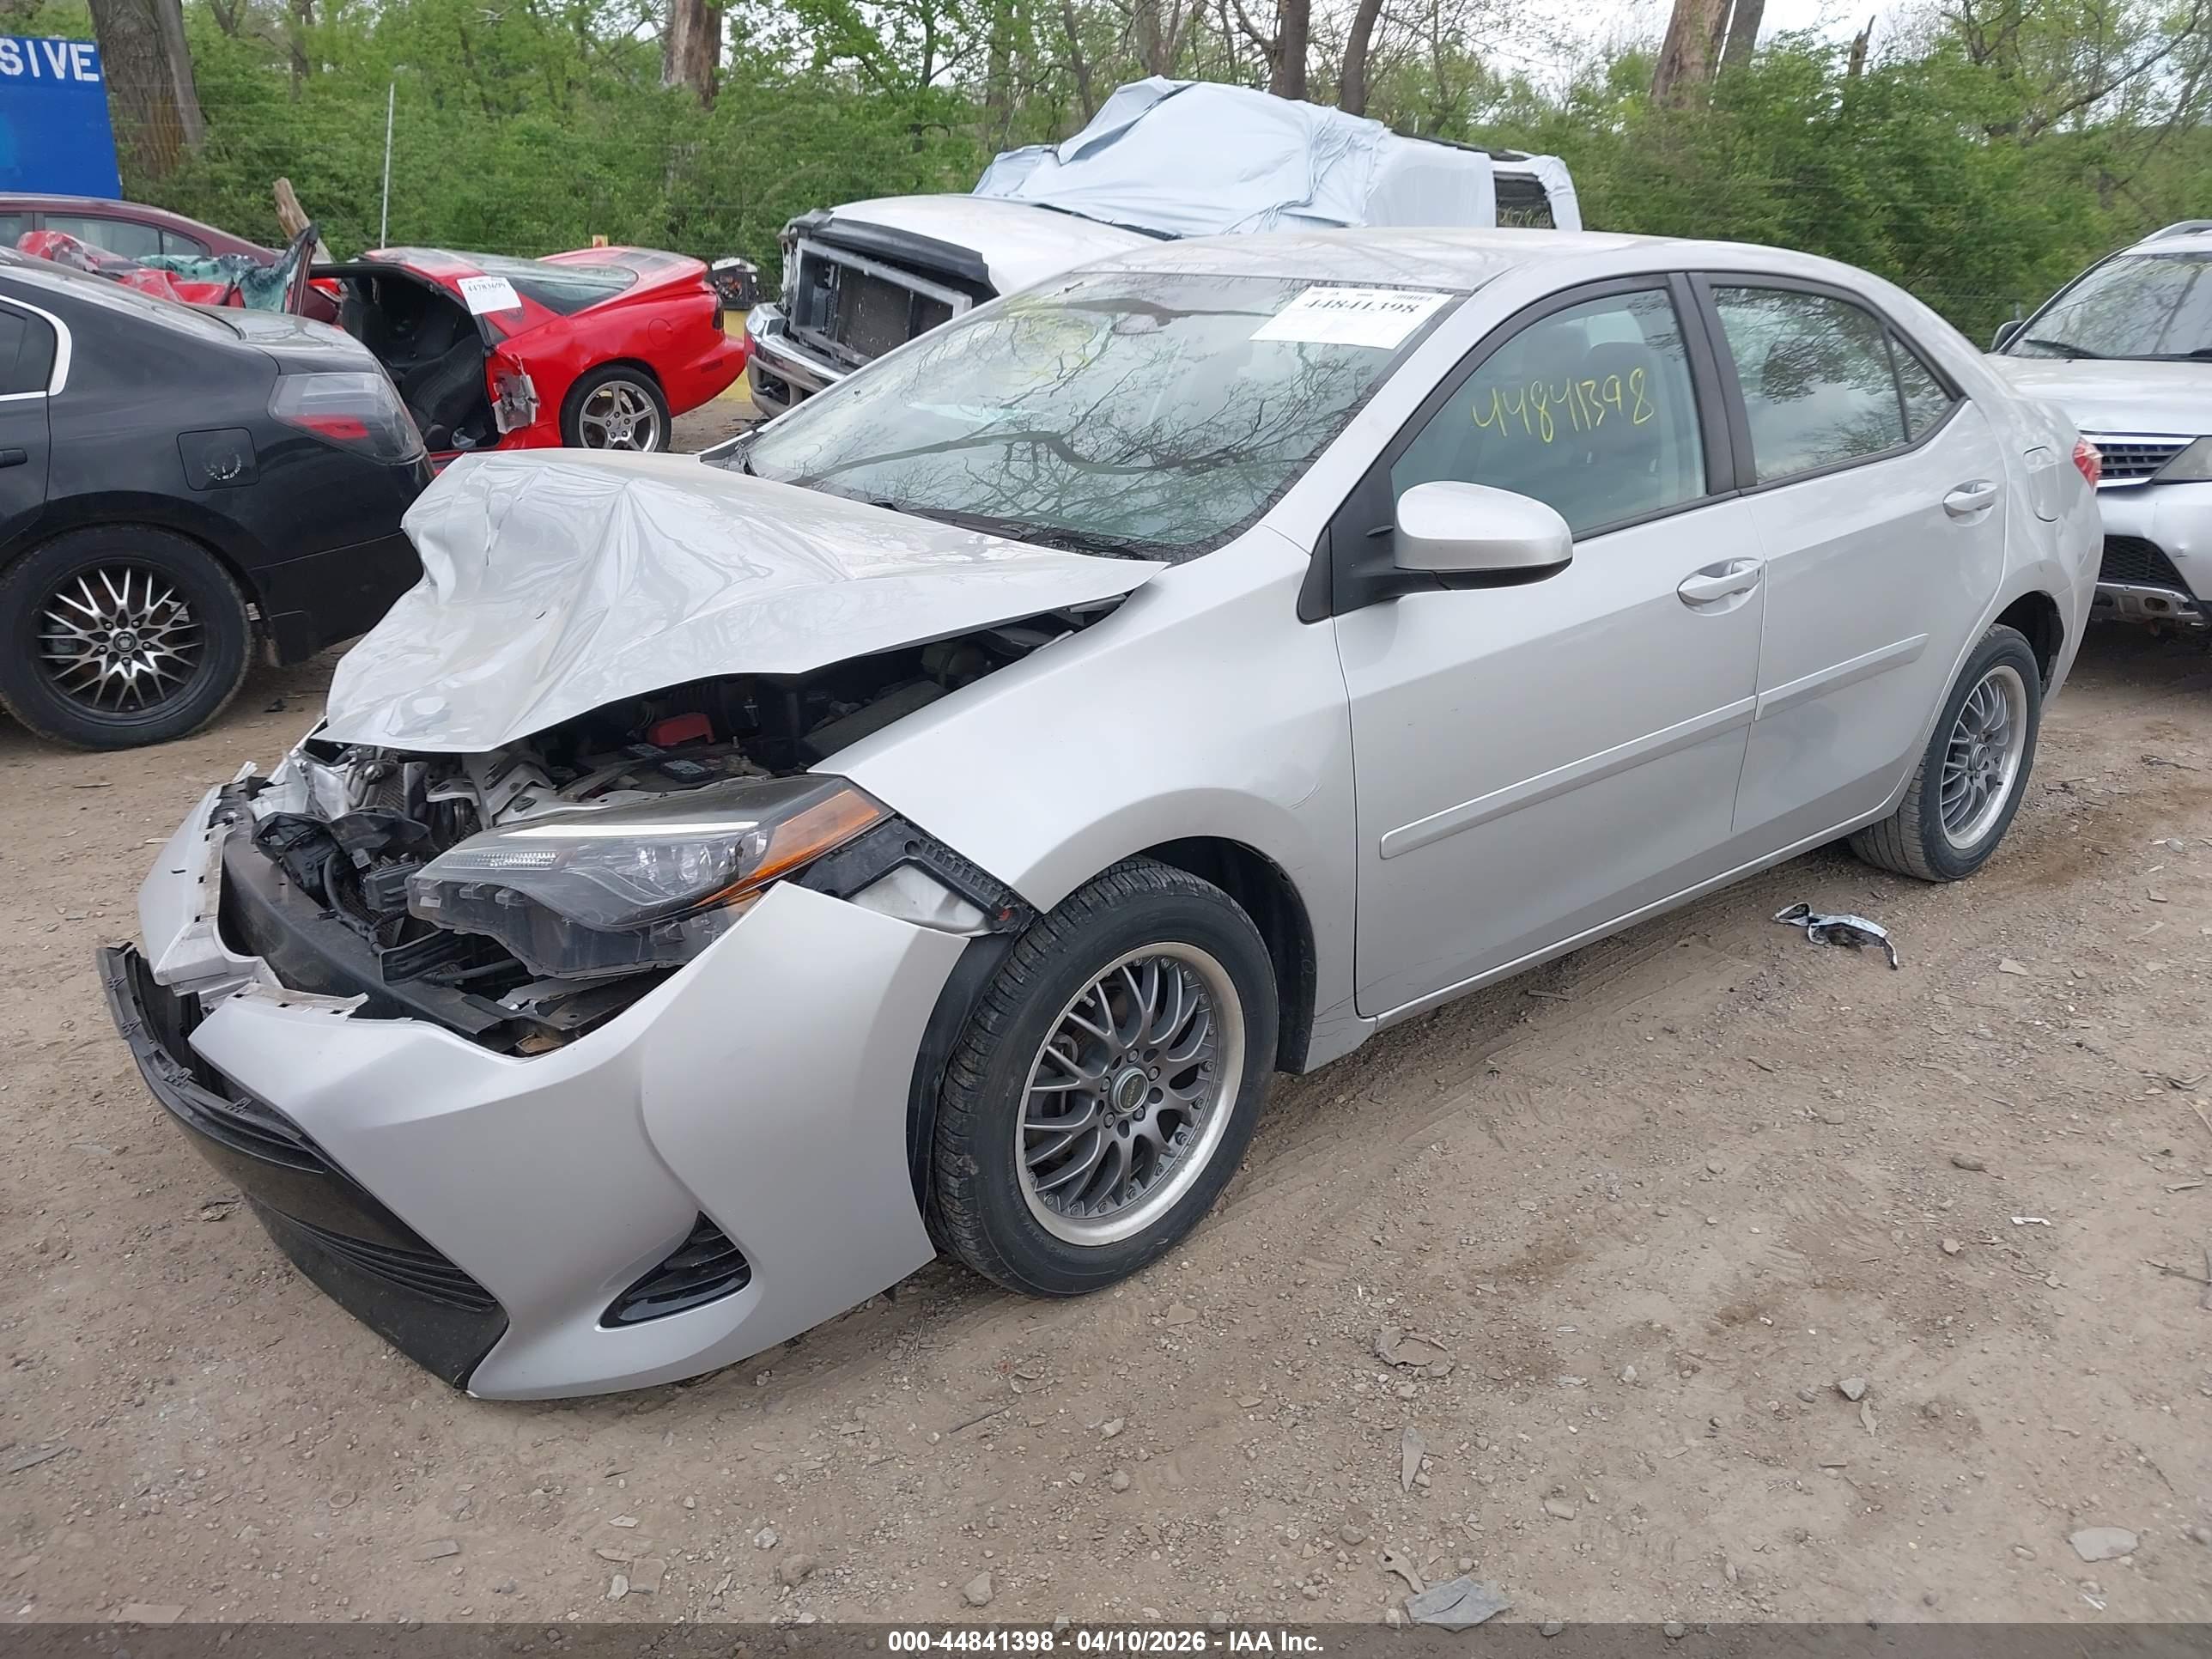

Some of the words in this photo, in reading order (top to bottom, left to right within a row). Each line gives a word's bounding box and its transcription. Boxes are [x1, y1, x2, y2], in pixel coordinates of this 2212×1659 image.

[0, 38, 100, 82] SIVE
[1304, 298, 1420, 313] 44841398
[1472, 368, 1655, 443] 44841398
